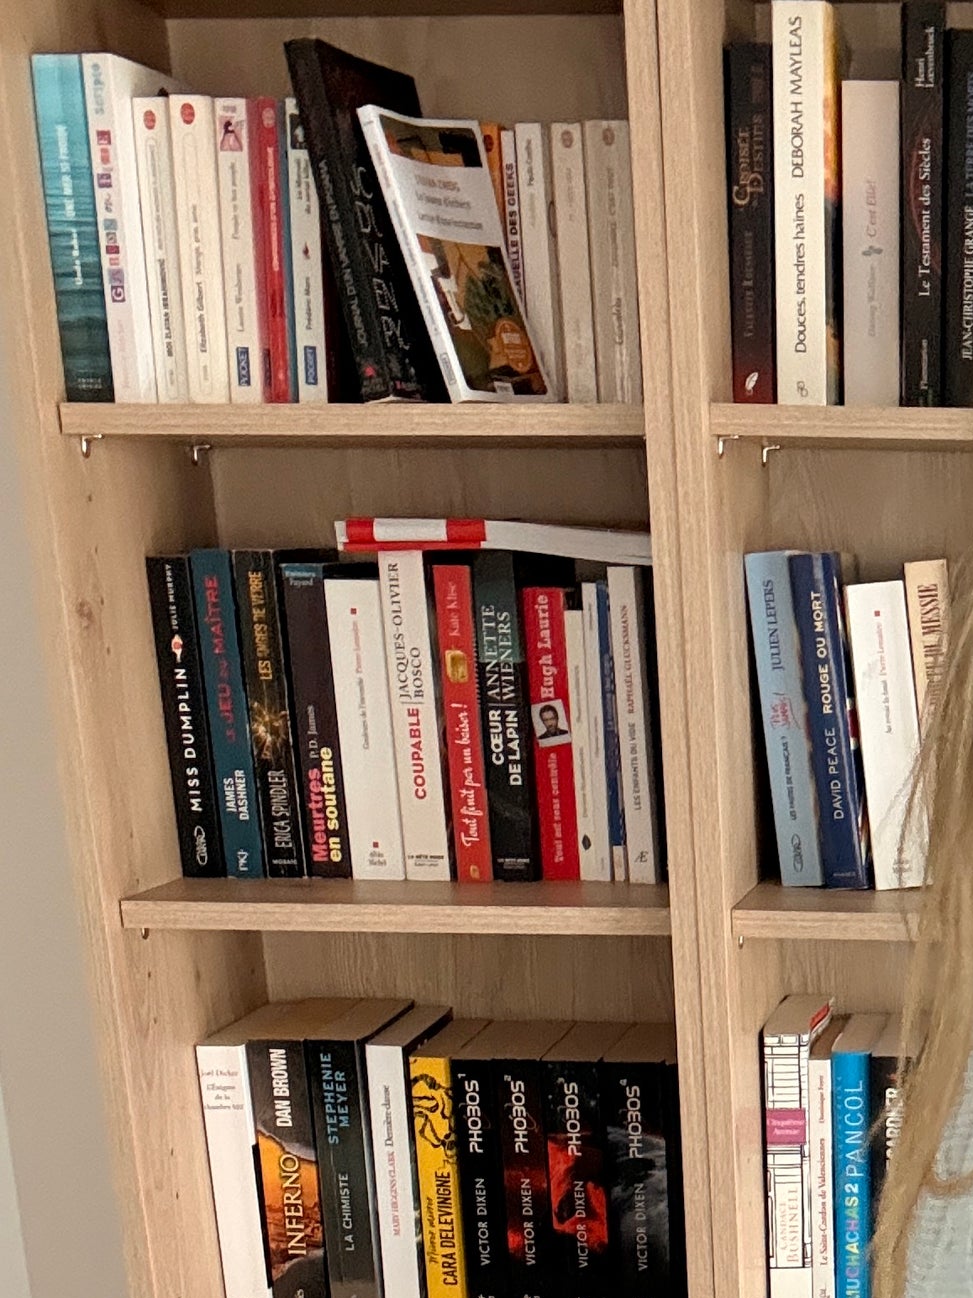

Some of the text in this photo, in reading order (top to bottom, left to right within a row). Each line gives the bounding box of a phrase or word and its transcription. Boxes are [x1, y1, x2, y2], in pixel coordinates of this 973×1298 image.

[788, 16, 804, 178] DEBORAH MAYLEAS
[914, 57, 926, 88] Henri
[505, 163, 518, 235] DES GEEKS
[793, 194, 806, 240] haines
[917, 138, 931, 296] Le Testament des Siècles
[794, 243, 806, 295] tendres
[195, 282, 208, 353] Elizabeth Gilbert
[237, 347, 249, 386] POCKET
[165, 564, 180, 629] JULIE MURPHY
[386, 562, 412, 700] JACQUES-OLIVIER
[446, 611, 460, 636] Kate
[763, 580, 785, 671] JULIEN LEPERS
[918, 583, 942, 637] MESSIE
[204, 576, 234, 723] JEU MAÎTRE
[258, 660, 273, 680] LES
[410, 646, 424, 698] BOSCO
[480, 604, 501, 700] ANNETTE
[496, 611, 515, 700] WIENERS
[536, 594, 556, 699] Hugh Laurie
[174, 668, 197, 758] DUMPLIN
[305, 705, 317, 735] James
[489, 710, 505, 765] CŒUR
[811, 591, 844, 819] DAVID PEACE ROUGE OU MORT
[407, 707, 428, 800] COUPABLE
[455, 711, 480, 847] Tout finit par un baiser
[505, 710, 522, 786] DE LAPIN
[186, 767, 203, 811] MISS
[223, 777, 237, 812] JAMES
[235, 769, 249, 820] DASHNER
[268, 769, 293, 847] ERICA SPINDLER
[307, 768, 328, 861] Meurtres
[319, 747, 342, 861] en soutane
[633, 794, 642, 810] LES
[269, 1049, 293, 1127] DAN BROWN
[320, 1052, 340, 1145] STEPHENIE
[335, 1071, 350, 1127] MEYER
[383, 1118, 394, 1147] Dernière
[843, 1080, 864, 1177] PANCOL
[280, 1153, 307, 1255] INFERNO
[339, 1173, 355, 1251] LA CHIMISTE
[435, 1171, 458, 1285] CARA DELEVINGNE
[474, 1178, 488, 1215] DIXEN
[520, 1178, 532, 1215] DIXEN
[574, 1181, 586, 1218] DIXEN
[634, 1183, 646, 1220] DIXEN
[786, 1186, 800, 1263] BUSHNELL
[817, 1138, 829, 1266] Le de Valenciennes
[477, 1221, 491, 1265] VICTOR
[524, 1221, 536, 1265] VICTOR
[576, 1224, 589, 1268] VICTOR
[636, 1226, 648, 1271] VICTOR
